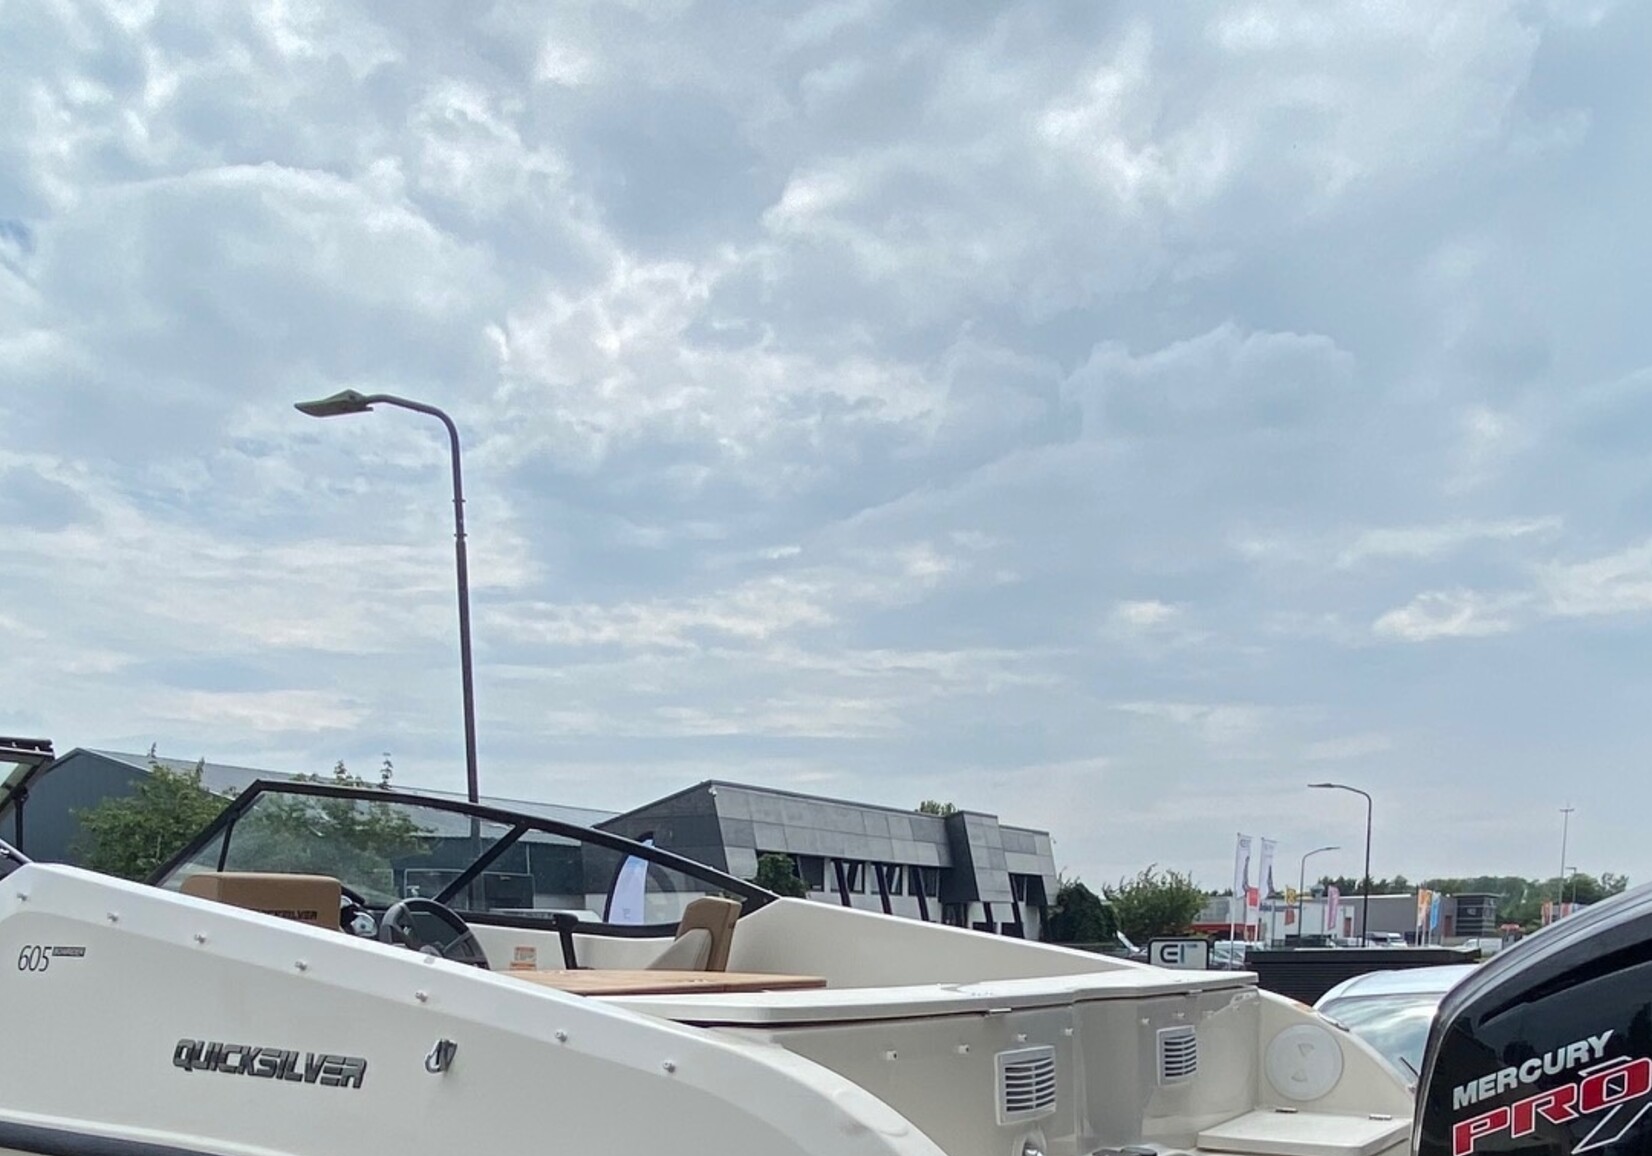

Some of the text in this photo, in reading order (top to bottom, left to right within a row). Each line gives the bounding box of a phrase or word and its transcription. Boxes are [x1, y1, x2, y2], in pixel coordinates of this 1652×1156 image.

[17, 945, 52, 972] 605
[172, 1038, 367, 1089] QUICKSILVER
[1452, 1029, 1614, 1110] MERCURY
